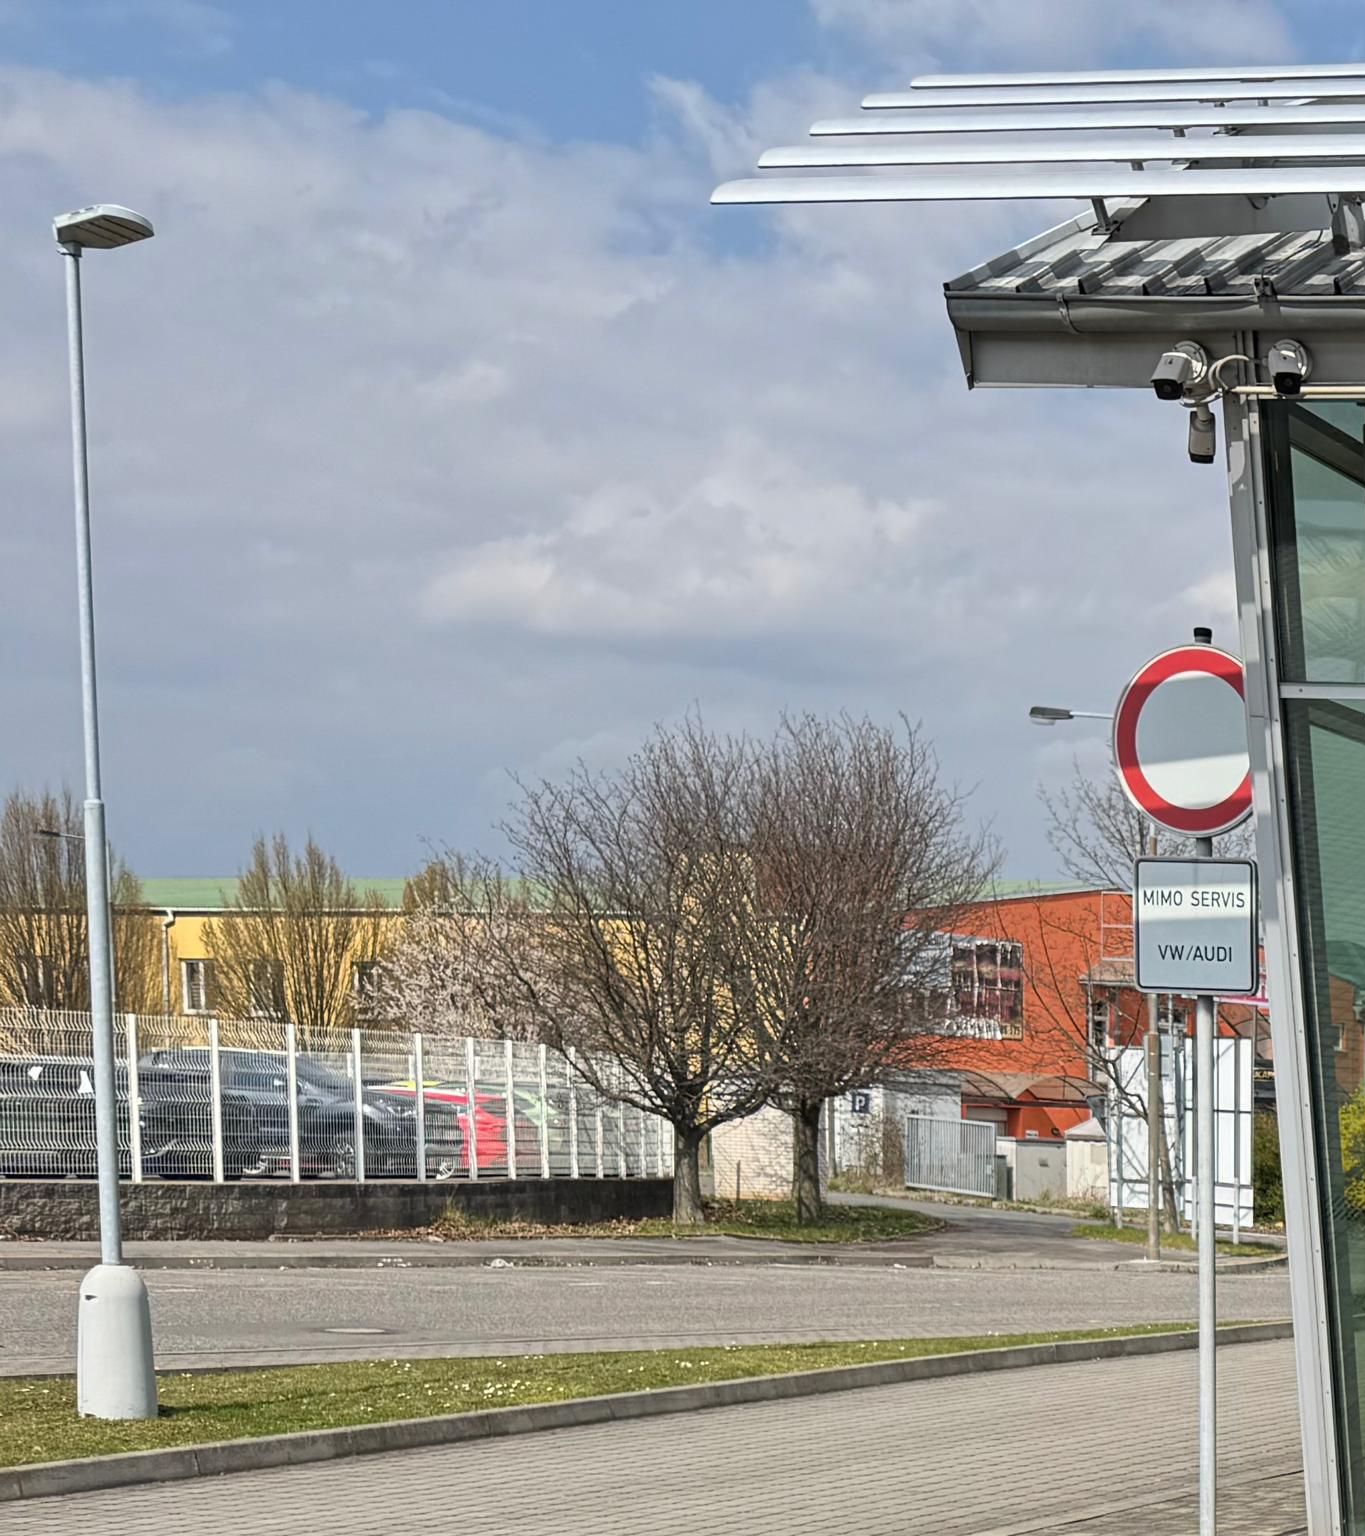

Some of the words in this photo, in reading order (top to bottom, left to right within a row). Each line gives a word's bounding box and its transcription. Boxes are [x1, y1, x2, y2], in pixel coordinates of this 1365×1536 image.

[1143, 889, 1183, 906] MIMO
[1191, 891, 1245, 908] SERVIS
[1158, 945, 1232, 963] VW/AUDI
[855, 1095, 866, 1111] P
